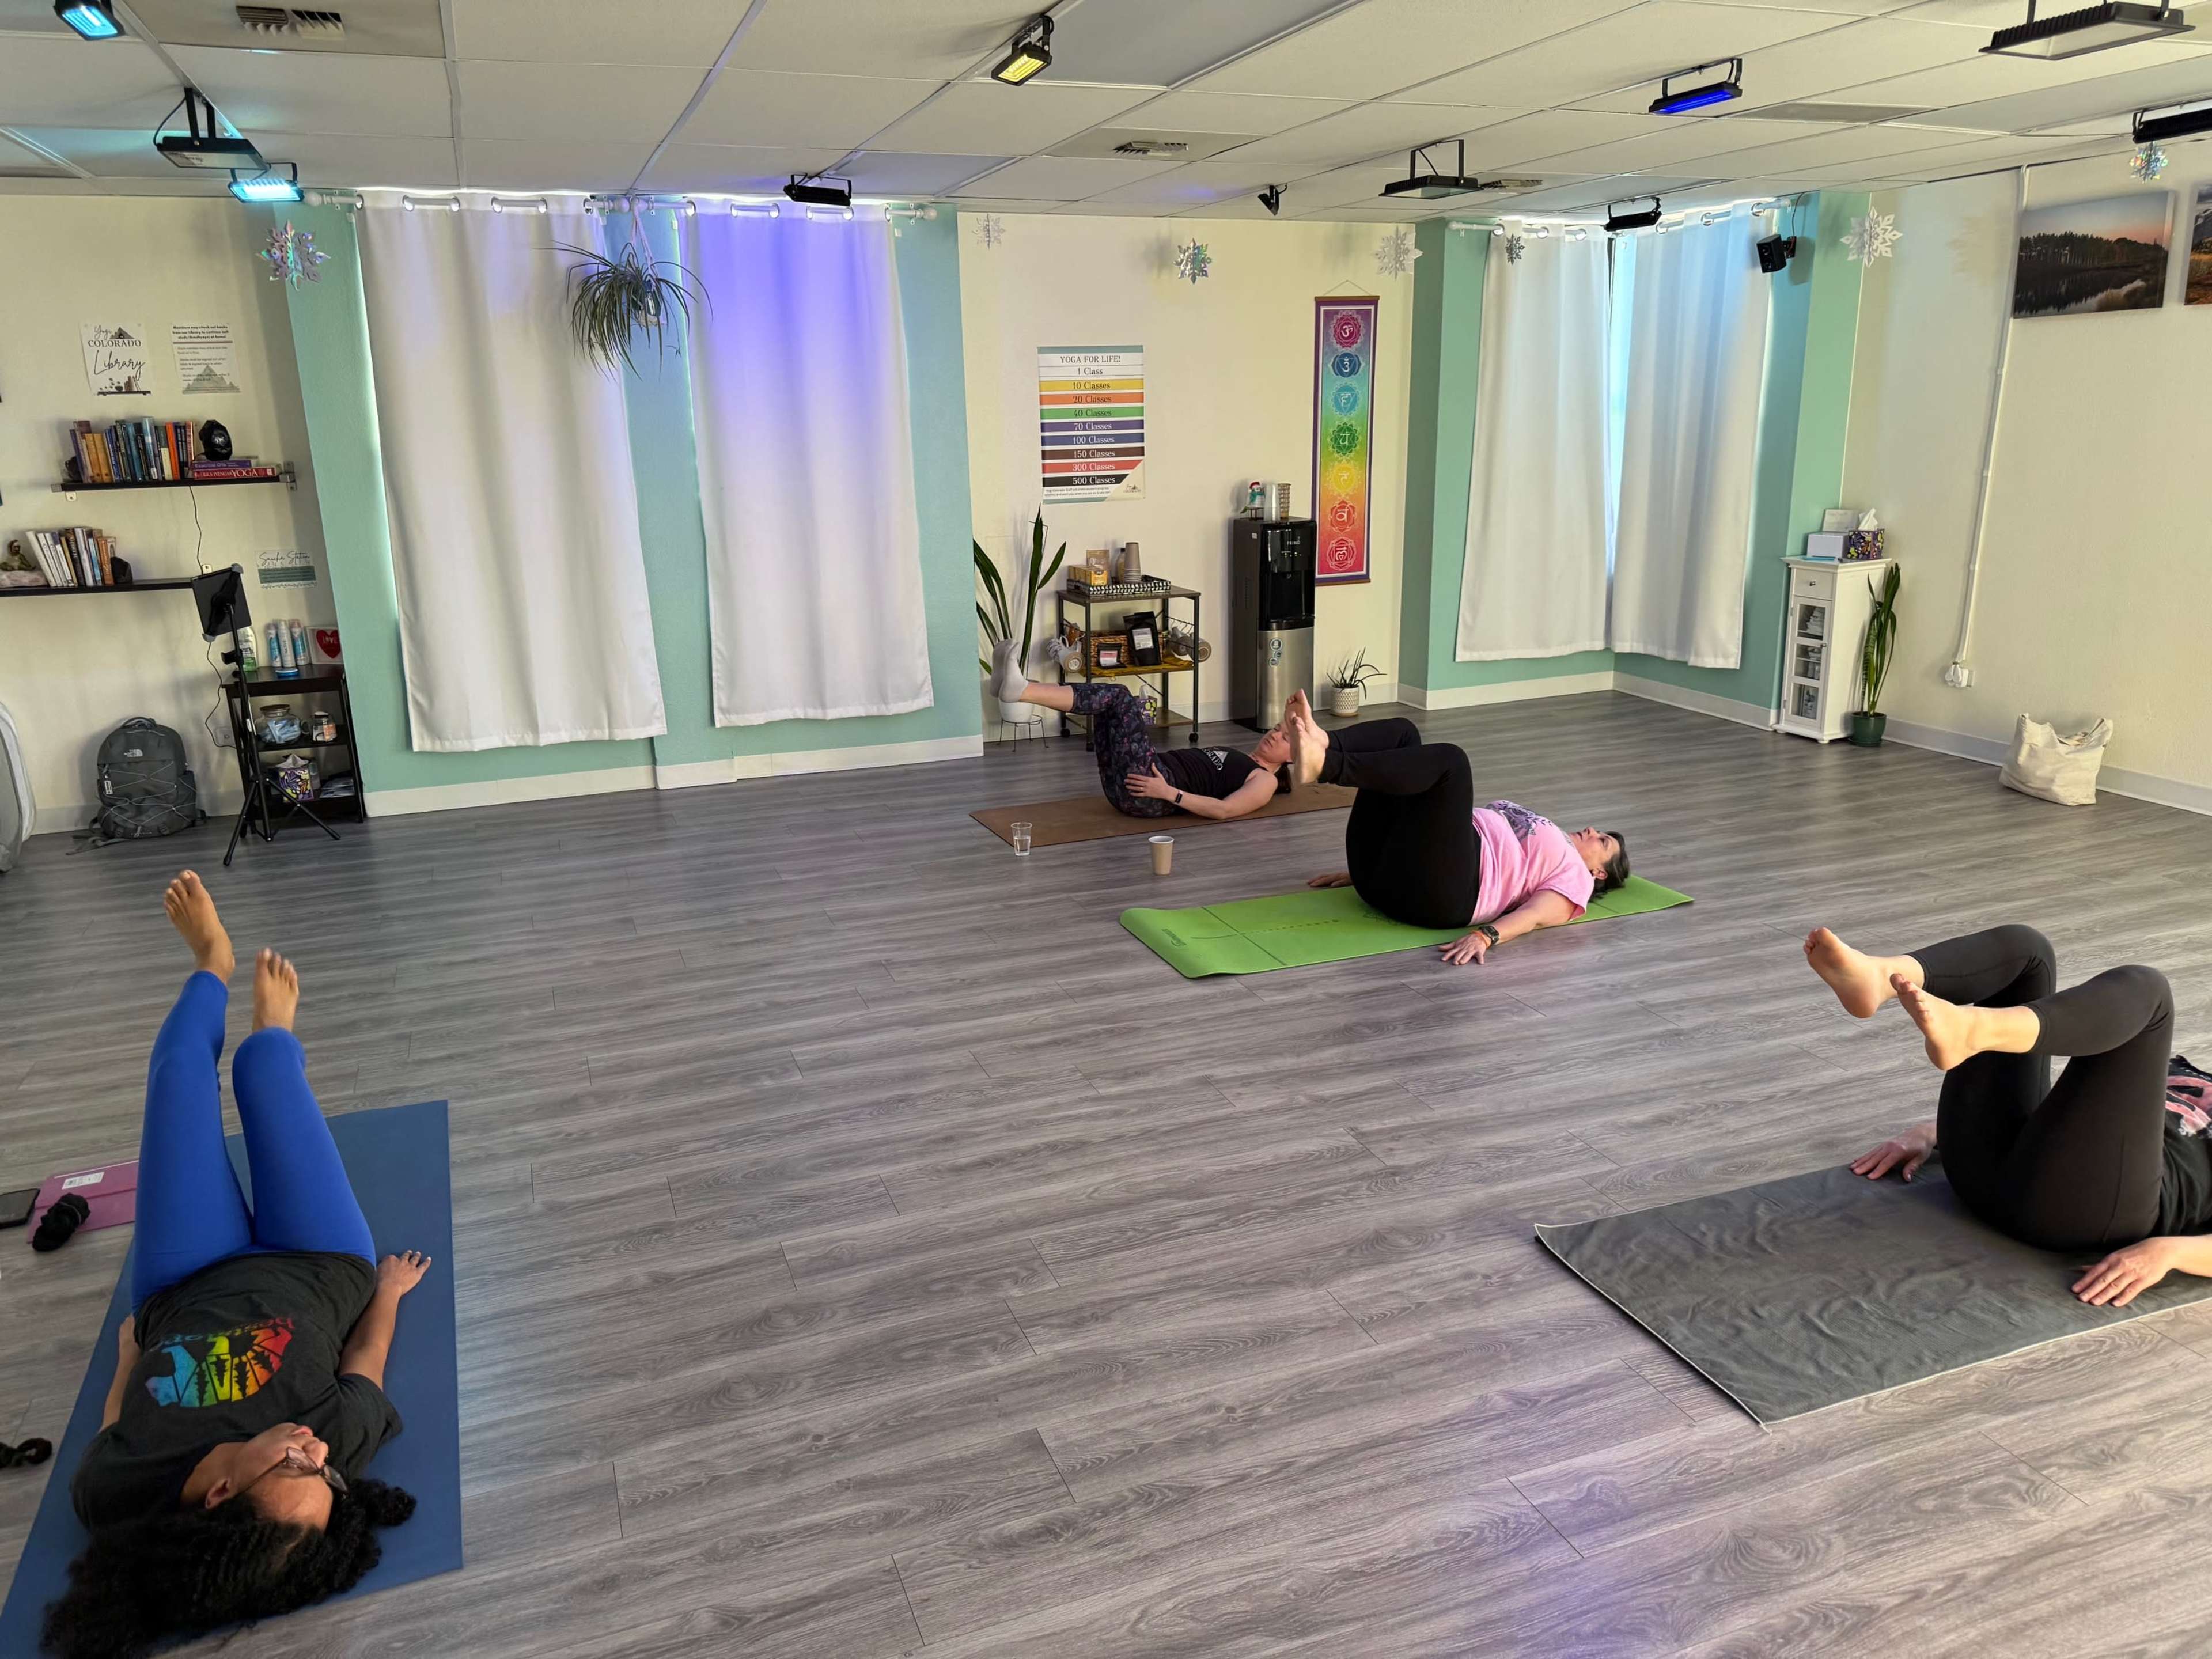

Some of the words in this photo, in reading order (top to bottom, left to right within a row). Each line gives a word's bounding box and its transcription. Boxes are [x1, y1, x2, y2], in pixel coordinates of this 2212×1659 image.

[94, 350, 146, 381] Library
[1084, 367, 1103, 375] Class
[1073, 381, 1081, 389] 10
[1084, 381, 1111, 389] Classes
[1073, 395, 1082, 403] 20
[1085, 395, 1112, 403] Classes
[1085, 408, 1112, 416] Classes
[1085, 422, 1112, 430] Classes
[1073, 436, 1086, 444] 100
[1088, 435, 1115, 444] Classes
[1074, 450, 1087, 458] 150
[1089, 449, 1115, 457] Classes
[1073, 463, 1087, 471] 300
[231, 469, 258, 477] YOGA
[1089, 476, 1115, 484] Classes
